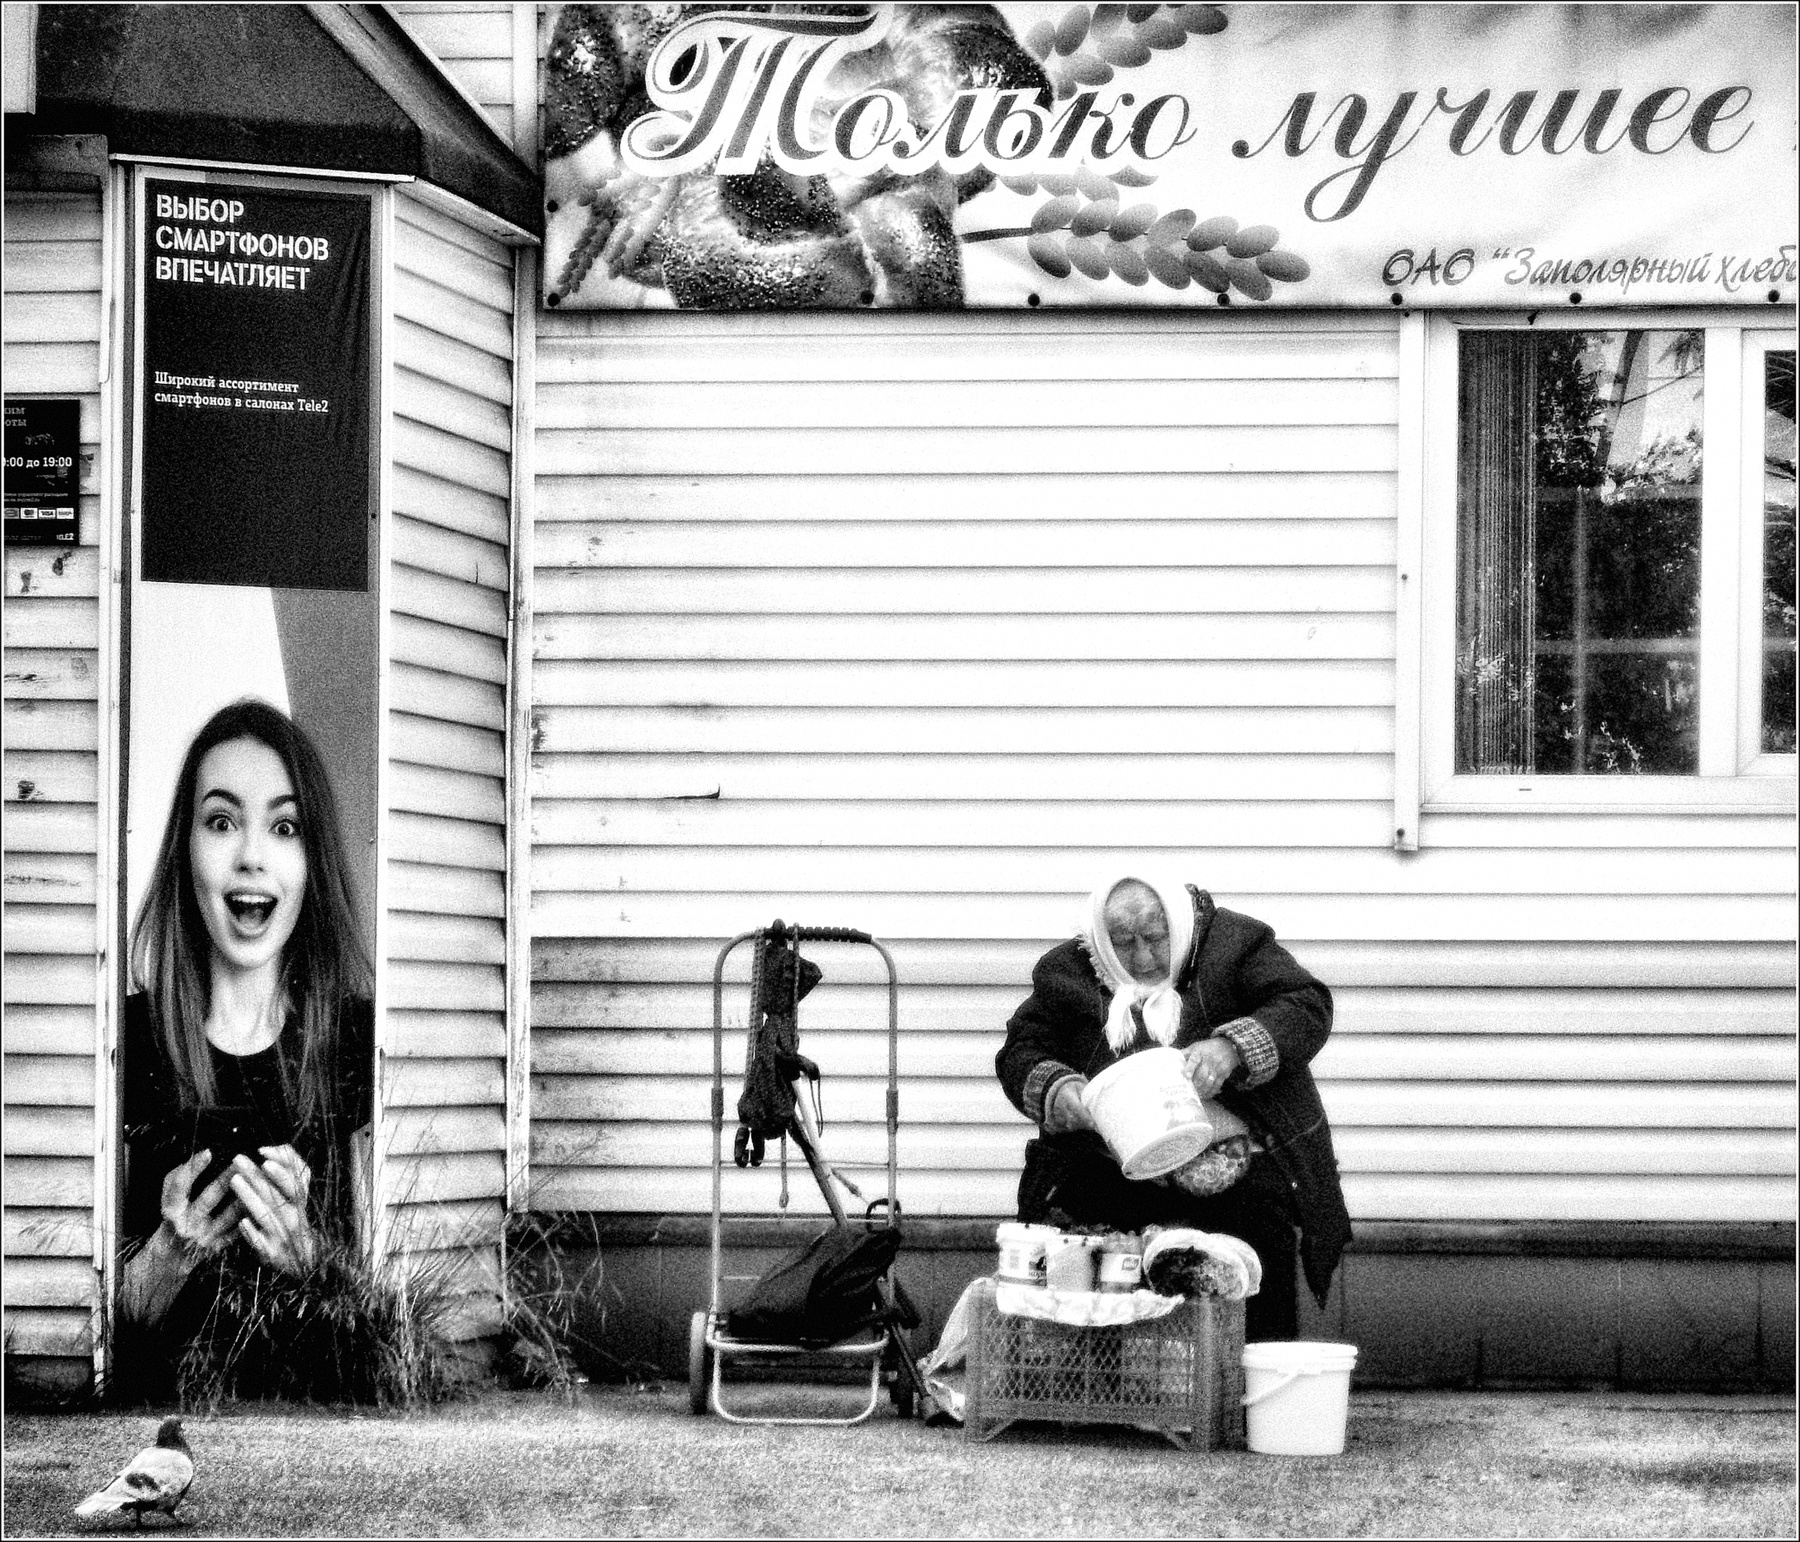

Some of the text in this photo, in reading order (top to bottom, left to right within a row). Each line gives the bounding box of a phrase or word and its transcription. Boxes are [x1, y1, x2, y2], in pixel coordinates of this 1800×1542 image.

[622, 8, 1755, 223] Только лучшее
[156, 194, 244, 223] ВЫБОР
[155, 225, 329, 261] СМАРТФОНОВ
[156, 256, 311, 290] ВПЕЧАТЛЯЕТ
[1382, 247, 1475, 286] ОАО
[154, 371, 299, 393] Широкий ассортимент
[154, 392, 329, 413] смартфонов в салонах Tele2
[26, 459, 40, 469] до
[43, 456, 73, 467] 19:00
